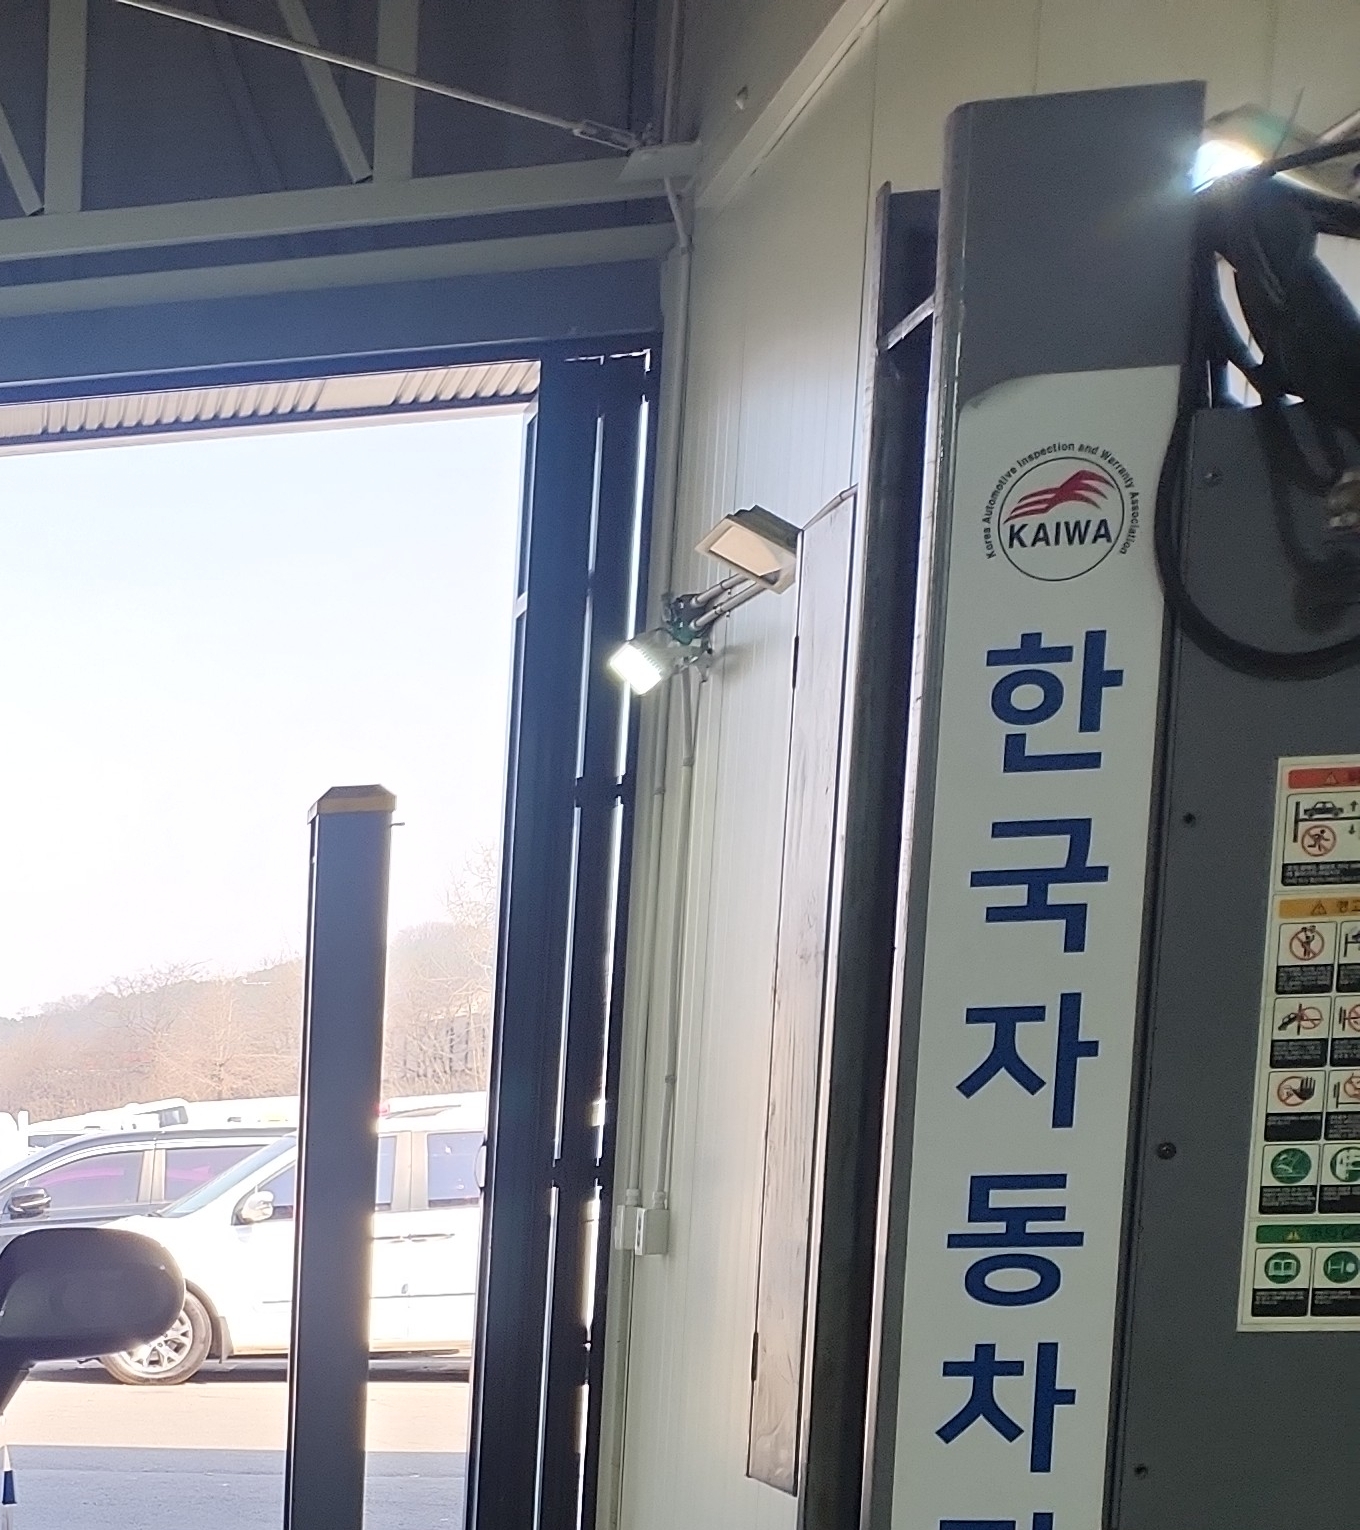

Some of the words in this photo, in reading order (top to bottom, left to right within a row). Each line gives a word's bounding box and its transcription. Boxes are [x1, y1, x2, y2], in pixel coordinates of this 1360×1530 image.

[1016, 442, 1075, 468] Inspection
[1078, 443, 1099, 455] and
[1100, 449, 1135, 490] Warranty
[982, 466, 1018, 525] Automotive
[1008, 518, 1113, 549] KAIWA
[1118, 491, 1140, 556] Association
[983, 526, 997, 560] Korea
